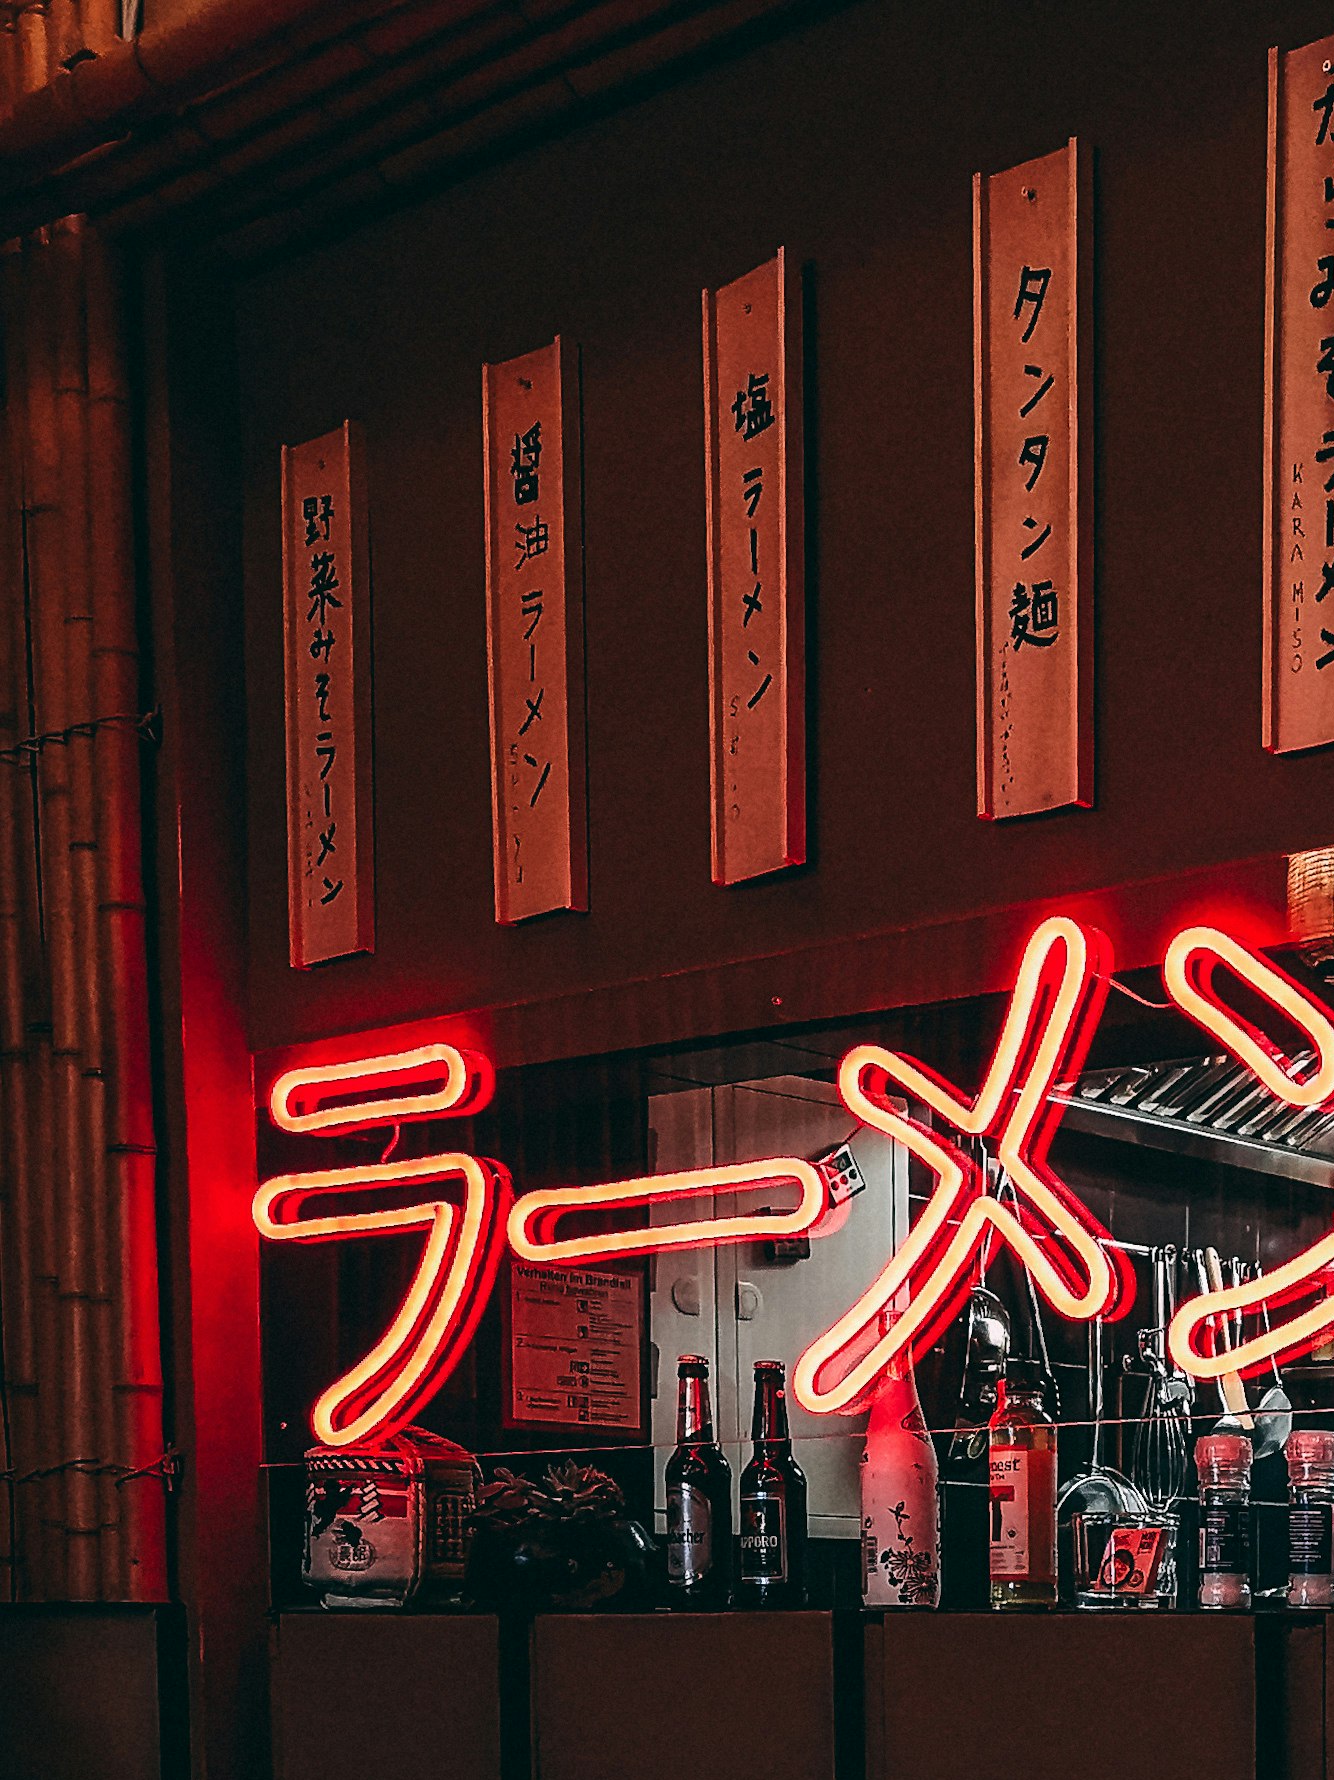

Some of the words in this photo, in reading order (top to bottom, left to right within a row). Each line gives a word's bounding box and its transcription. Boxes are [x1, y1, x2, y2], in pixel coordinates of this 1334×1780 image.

[303, 495, 344, 905] 野菜みそラーメン
[731, 373, 776, 709] 塩ラーメン
